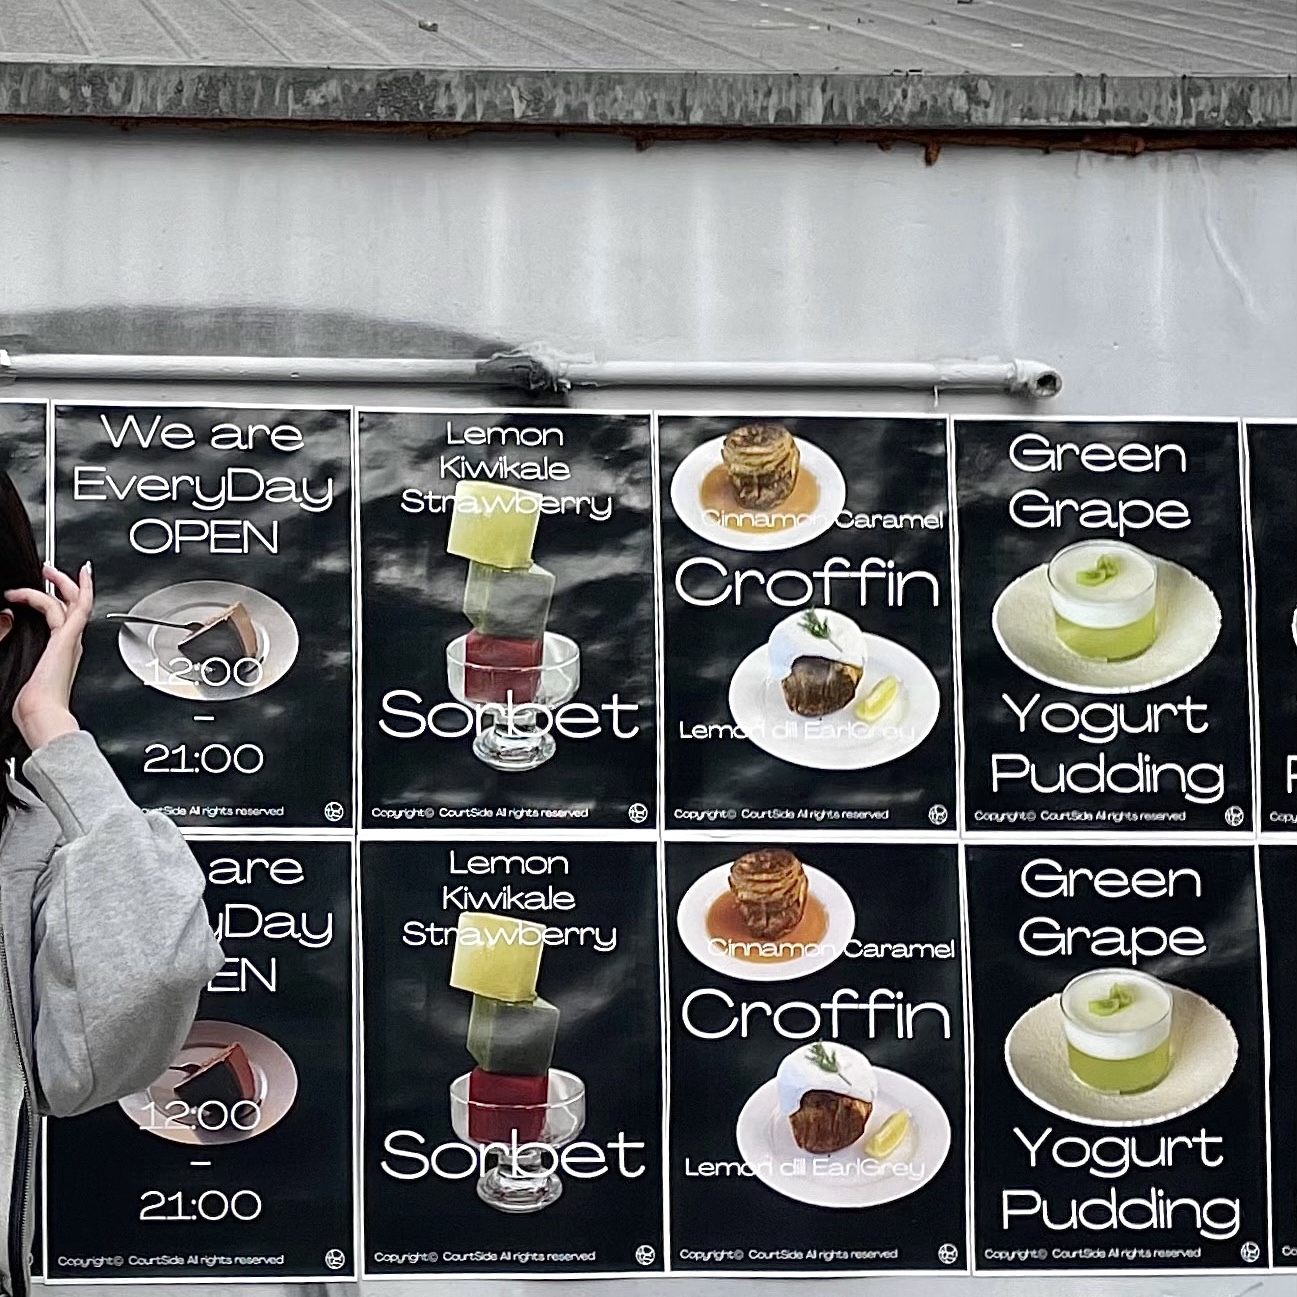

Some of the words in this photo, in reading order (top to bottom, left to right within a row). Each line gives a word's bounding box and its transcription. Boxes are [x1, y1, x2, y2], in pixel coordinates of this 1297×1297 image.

[101, 414, 195, 450] We
[211, 424, 305, 452] are
[447, 421, 563, 447] Lemon
[439, 455, 571, 482] Kiwikale
[1009, 433, 1187, 474] Green
[73, 466, 334, 512] EveryDay
[401, 489, 613, 520] Strawberry
[702, 509, 827, 529] Cinnamon
[836, 510, 943, 530] Caramel
[1009, 488, 1192, 538] Grape
[129, 518, 278, 554] OPEN
[675, 556, 939, 607] Croffin
[144, 656, 264, 688] 12:00
[379, 689, 639, 739] Sorbet
[1002, 693, 1209, 745] Yogurt
[679, 720, 766, 741] Lemon
[143, 742, 264, 775] 21:00
[991, 752, 1225, 805] Pudding
[189, 806, 201, 816] All
[202, 805, 233, 818] rights
[236, 806, 284, 816] reserved
[495, 807, 507, 817] All
[509, 807, 539, 819] rights
[541, 808, 588, 818] reserved
[797, 809, 808, 819] All
[809, 809, 840, 821] rights
[841, 809, 889, 819] reserved
[1095, 810, 1106, 820] All
[1107, 810, 1138, 823] rights
[1140, 811, 1186, 821] reserved
[208, 857, 304, 885] are
[449, 850, 569, 876] Lemon
[1020, 857, 1202, 899] Green
[442, 885, 576, 911] Kiwikale
[402, 921, 617, 952] Strawberry
[707, 938, 835, 958] Cinnamon
[843, 938, 956, 959] Caramel
[1018, 916, 1207, 966] Grape
[207, 957, 277, 992] EN
[682, 988, 950, 1040] Croffin
[139, 1100, 262, 1131] 12:00
[381, 1129, 646, 1180] Sorbet
[1012, 1126, 1224, 1178] Yogurt
[685, 1157, 773, 1177] Lemon
[779, 1156, 807, 1177] dill
[812, 1157, 926, 1182] EarlGrey
[139, 1189, 261, 1221] 21:00
[1002, 1187, 1240, 1240] Pudding
[187, 1255, 199, 1265] All
[200, 1254, 232, 1267] rights
[234, 1255, 284, 1265] reserved
[500, 1251, 511, 1261] All
[513, 1250, 545, 1263] rights
[547, 1251, 596, 1261] reserved
[806, 1249, 817, 1259] All
[819, 1248, 849, 1261] rights
[851, 1249, 898, 1259] reserved
[1108, 1248, 1119, 1258] All
[1121, 1247, 1151, 1261] rights
[1153, 1248, 1201, 1259] reserved
